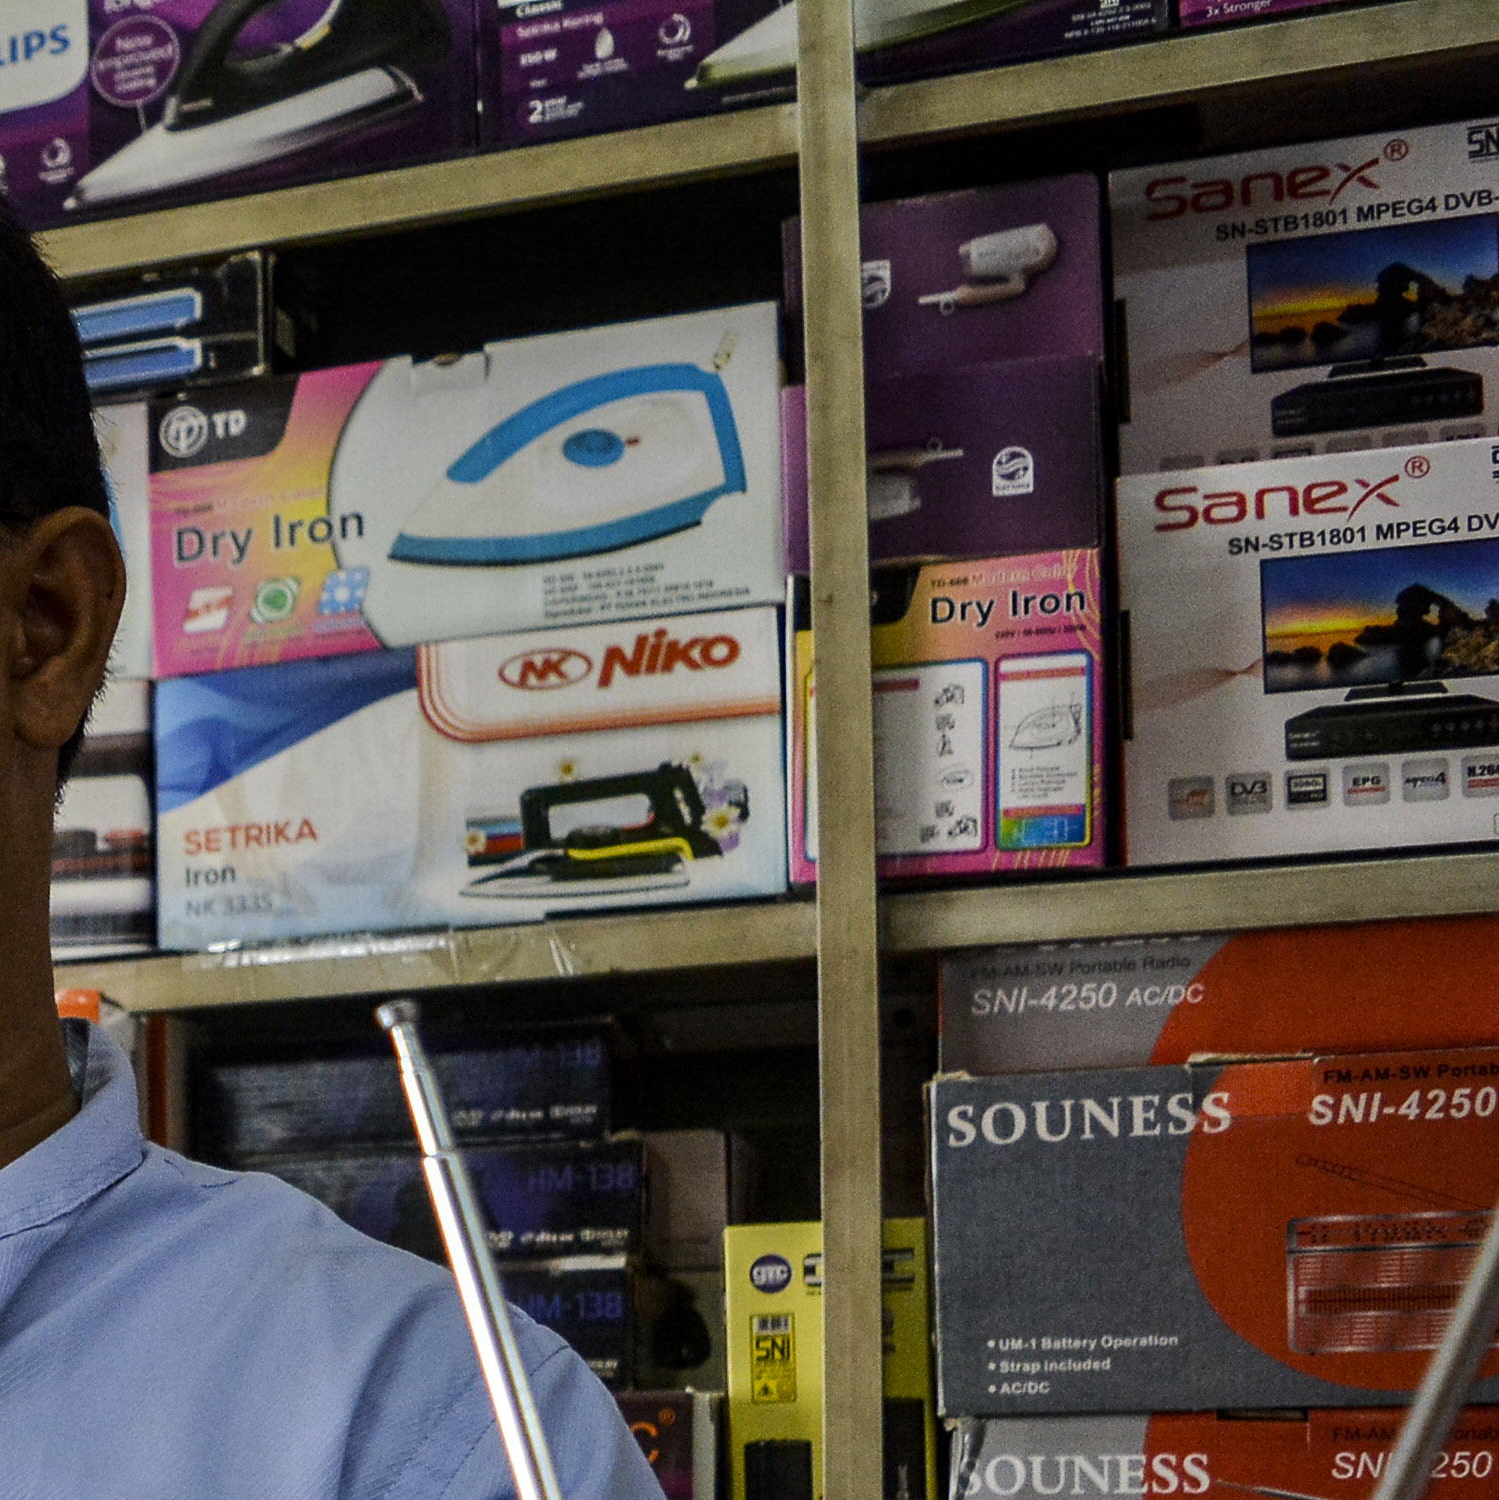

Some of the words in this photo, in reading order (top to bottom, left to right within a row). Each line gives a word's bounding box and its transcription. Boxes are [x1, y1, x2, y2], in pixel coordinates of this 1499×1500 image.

[528, 99, 544, 124] 2
[1145, 156, 1380, 222] Sanex
[1214, 207, 1349, 243] SN-STB1801
[1355, 193, 1439, 224] MPEG4
[1443, 187, 1499, 212] DVB-
[211, 408, 247, 439] TD
[1154, 473, 1401, 533] Sanex
[175, 525, 253, 567] Dry
[272, 511, 365, 549] Iron
[1228, 525, 1367, 556] SN-STB1801
[1375, 516, 1460, 542] MPEG4
[1467, 513, 1499, 532] DV
[929, 595, 996, 629] Dry
[1008, 586, 1088, 619] Iron
[183, 817, 318, 856] SETRIKA
[185, 864, 237, 887] Iron
[1068, 957, 1138, 976] Portable
[1142, 954, 1193, 970] Radio
[970, 983, 1118, 1016] SNI-4250
[1125, 982, 1206, 1008] AC/DC
[1322, 1064, 1433, 1084] FM-AM-SW
[1436, 1060, 1499, 1080] Portab
[945, 1090, 1234, 1149] SOUNESS
[1307, 1085, 1499, 1126] SNI-4250
[754, 1335, 793, 1362] SNI
[1040, 1334, 1098, 1351] Battery
[1100, 1332, 1180, 1349] Operation
[998, 1359, 1042, 1375] Strap
[999, 1380, 1052, 1395] AC/DC
